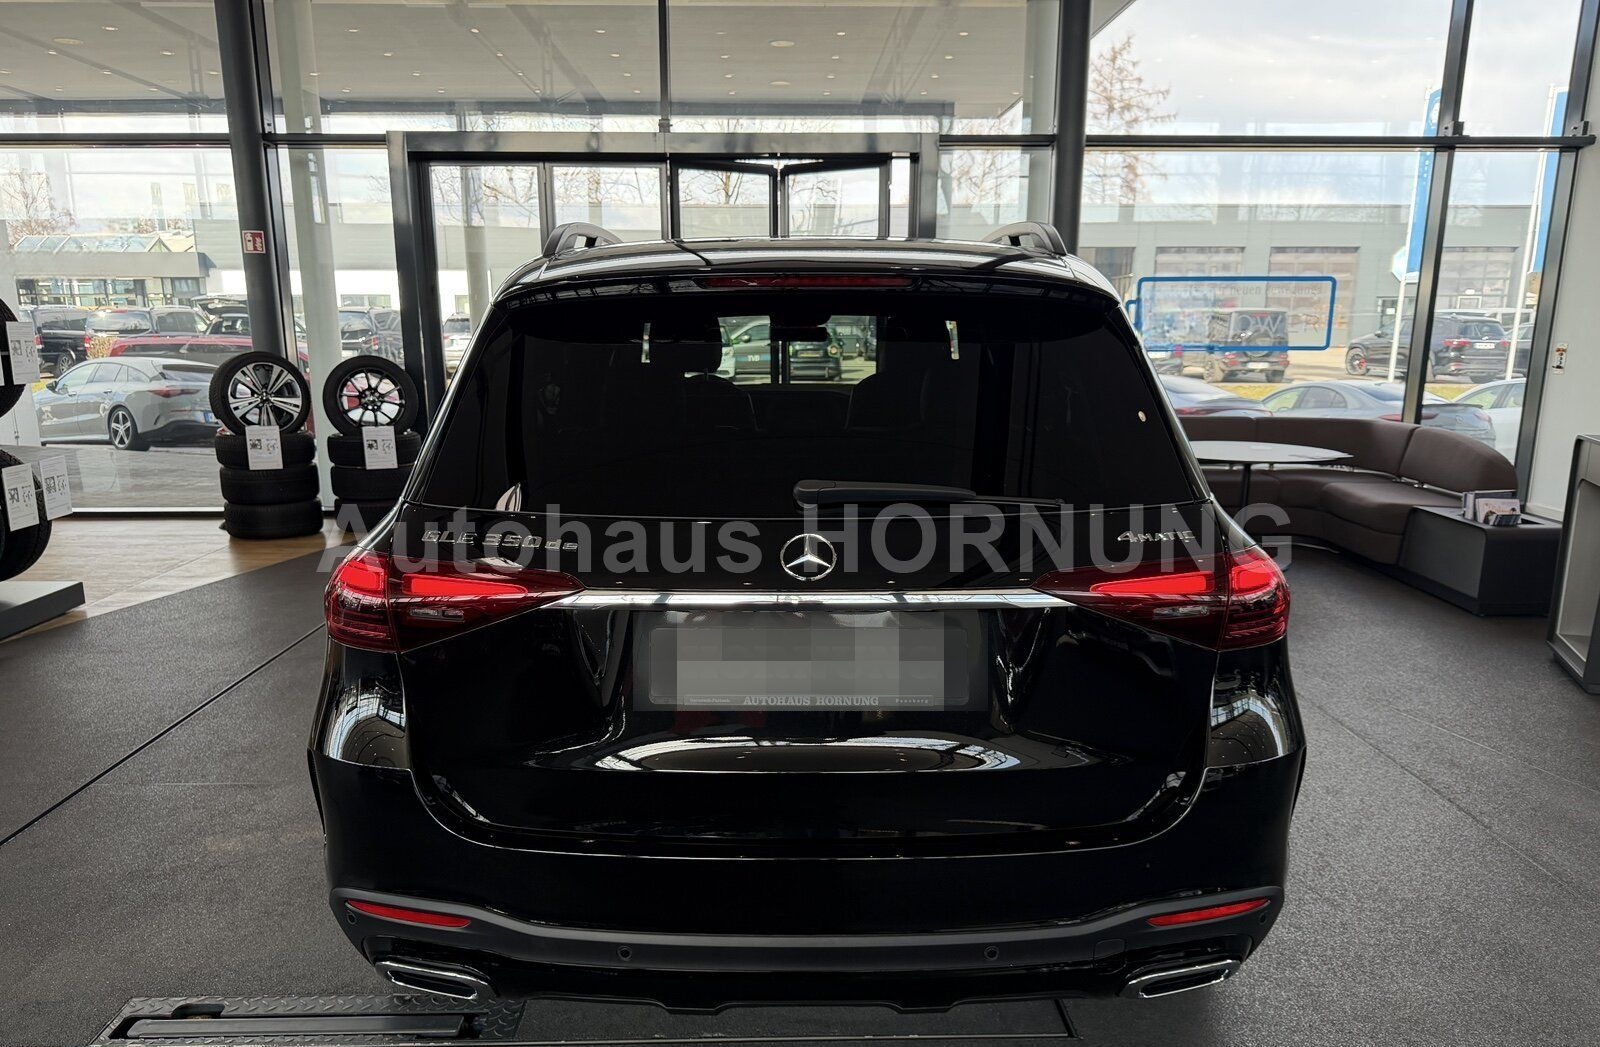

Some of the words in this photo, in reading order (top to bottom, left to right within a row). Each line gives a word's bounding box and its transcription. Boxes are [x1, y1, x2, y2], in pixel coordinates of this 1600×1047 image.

[422, 531, 478, 546] GLE
[482, 533, 543, 549] 350
[743, 696, 811, 706] AUTOHAUS
[816, 696, 879, 706] HORNUNG
